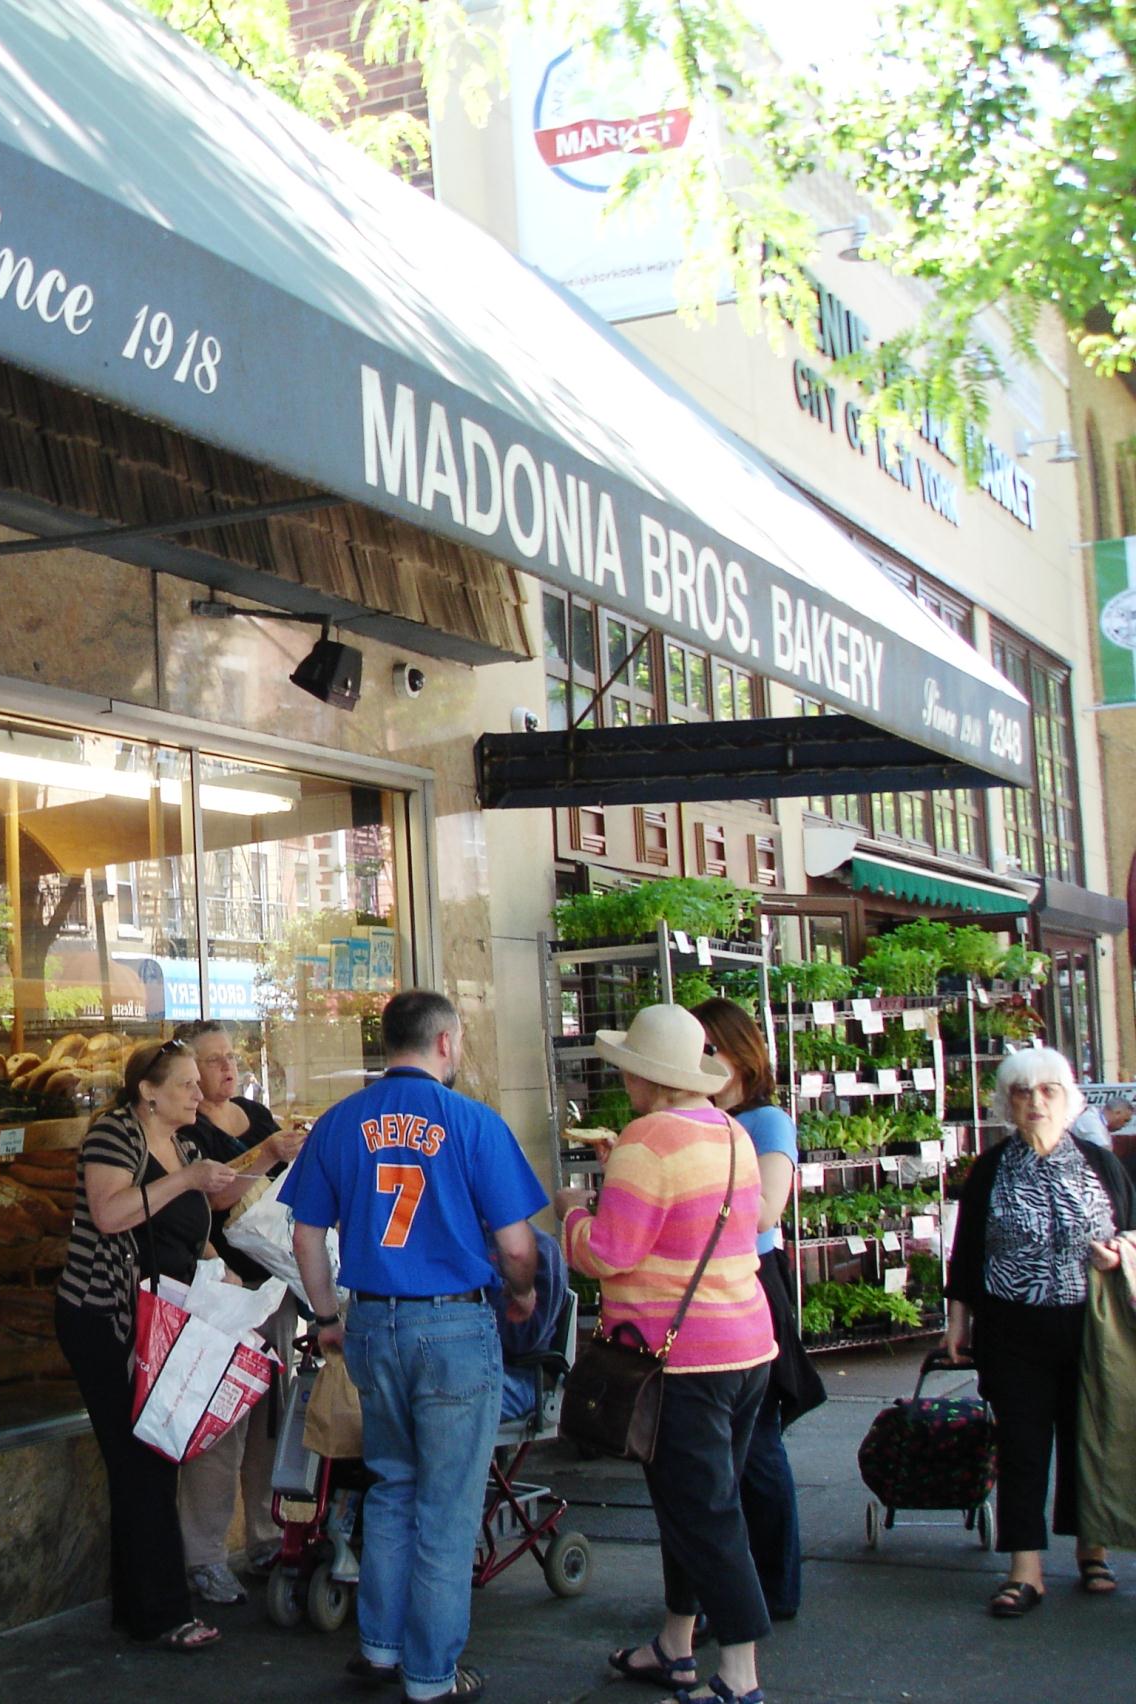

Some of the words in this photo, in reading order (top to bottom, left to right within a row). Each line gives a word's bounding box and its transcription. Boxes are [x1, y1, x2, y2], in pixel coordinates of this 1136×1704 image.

[555, 115, 675, 158] MARKET
[121, 305, 222, 394] 1918
[793, 358, 836, 435] CITY
[916, 457, 961, 529] YORK
[360, 363, 627, 598] MADONIA
[640, 514, 760, 659] BROS.
[769, 584, 883, 712] BAKERY
[361, 1113, 445, 1157] REYES
[376, 1163, 426, 1248] 7
